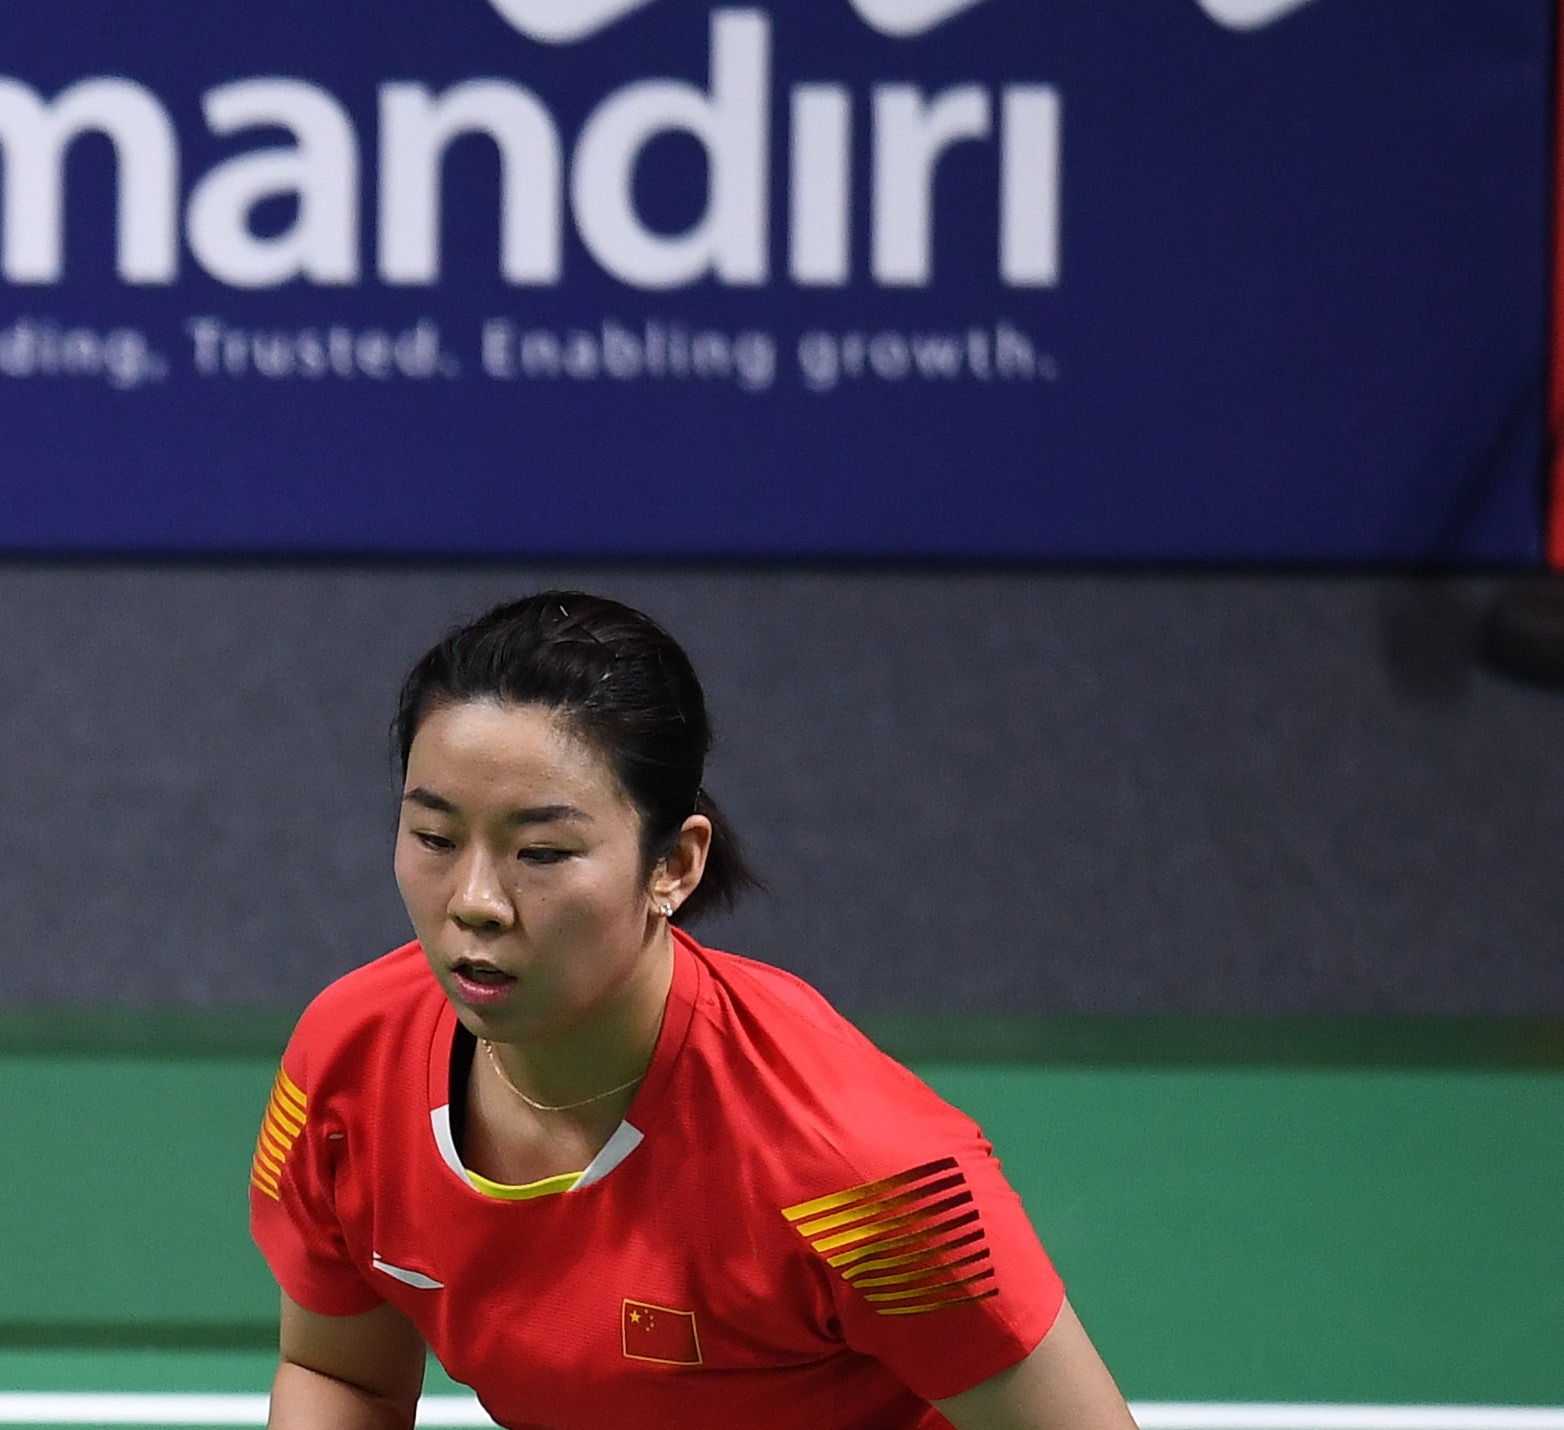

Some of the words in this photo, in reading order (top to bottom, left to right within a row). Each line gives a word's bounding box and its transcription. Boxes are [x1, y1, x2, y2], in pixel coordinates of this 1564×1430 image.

[190, 319, 460, 378] Trusted.
[482, 322, 778, 390] Enabling
[796, 322, 1058, 391] growth.
